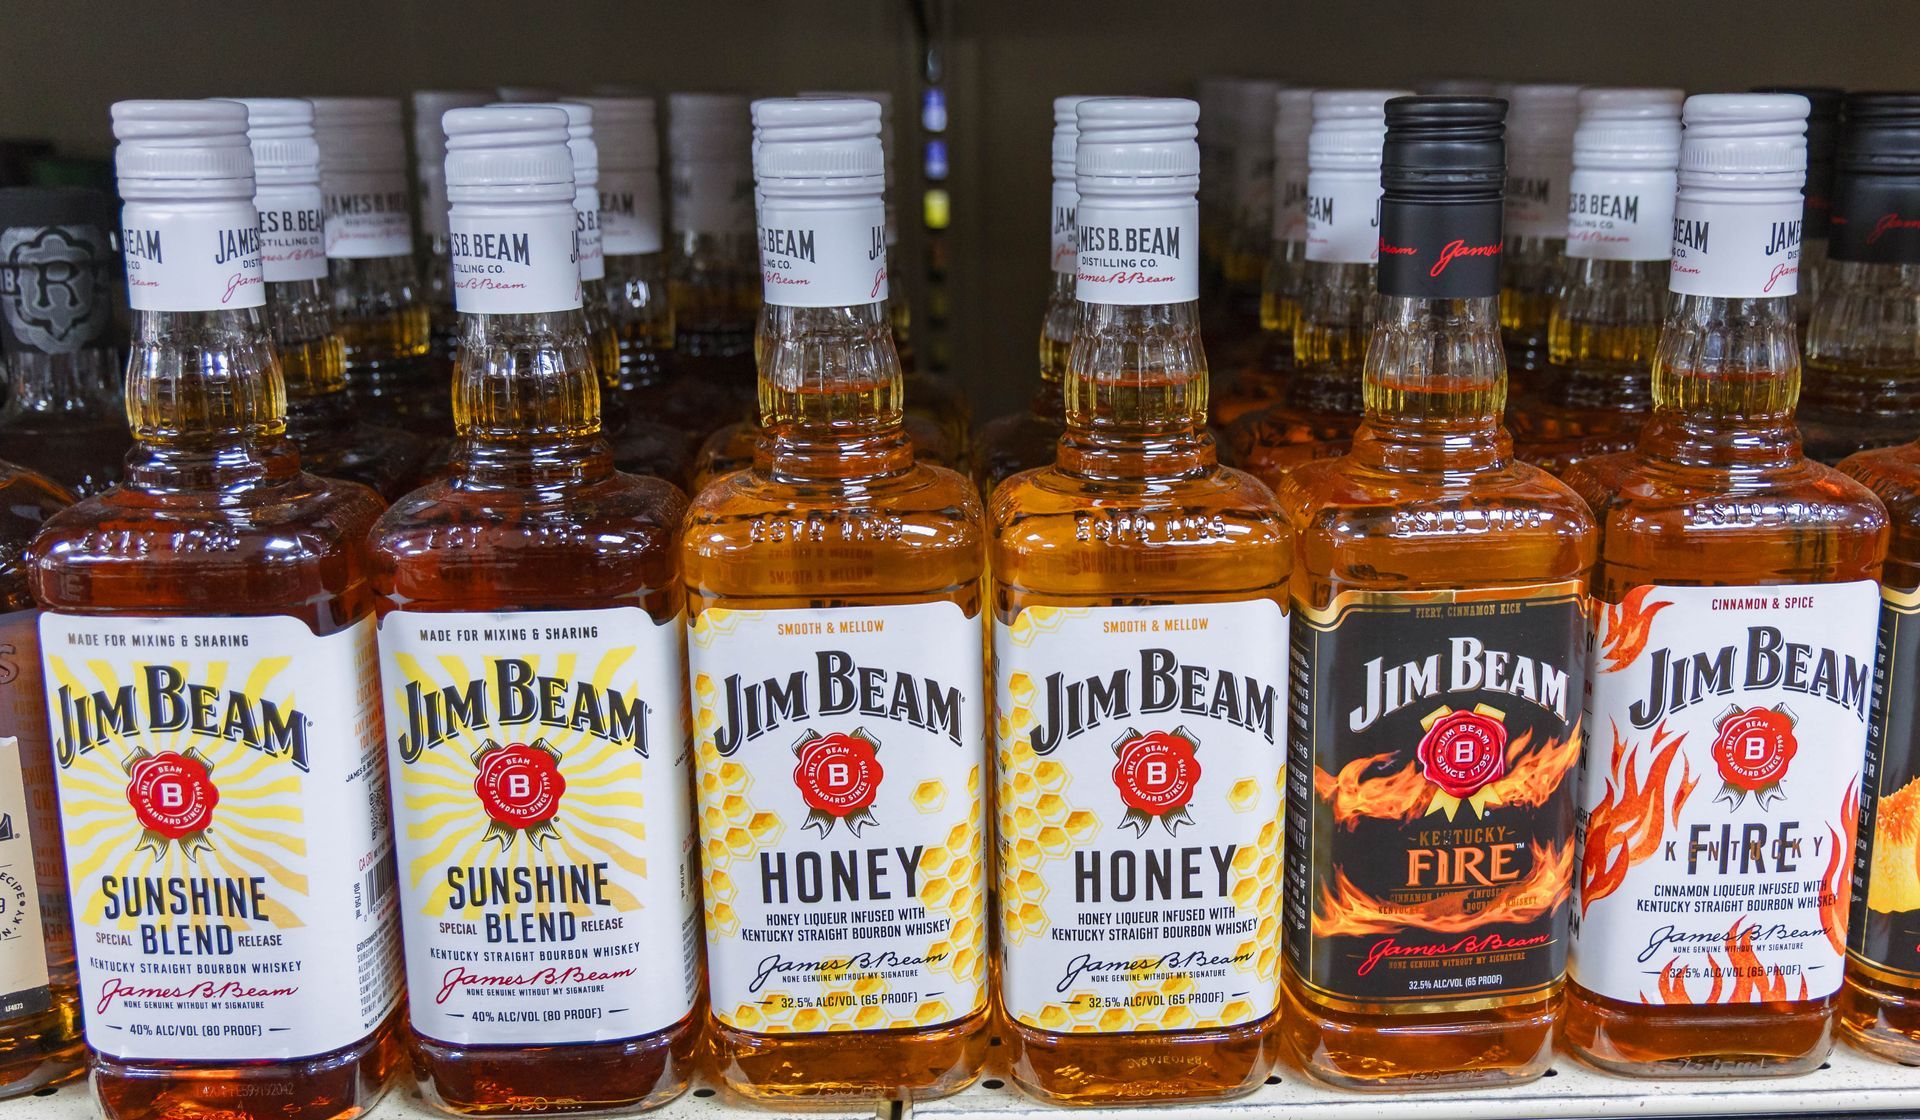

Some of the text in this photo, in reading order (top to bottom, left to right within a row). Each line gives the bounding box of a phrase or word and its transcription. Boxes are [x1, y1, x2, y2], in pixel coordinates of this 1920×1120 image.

[1055, 207, 1075, 234] JAM
[1590, 196, 1638, 223] BEAM
[215, 227, 259, 264] JAMES
[768, 230, 816, 263] BEAM
[1109, 228, 1122, 251] B.
[1126, 227, 1180, 259] BEAM
[1673, 218, 1709, 254] BEAM
[1766, 221, 1801, 255] JAME
[461, 234, 530, 266] B. BEAM
[1082, 257, 1158, 268] DISTILLING CO.
[1416, 603, 1521, 619] FIERY, CINNAMON KICK
[1712, 596, 1814, 610] CINNAMON & SPICE
[420, 626, 599, 642] MADE FOR MIXING & SHARING
[778, 620, 885, 636] SMOOTH & MELLOW
[1103, 618, 1209, 633] SMOOTH & MELLOW
[68, 633, 249, 648] MADE FOR MIXING & SHARING
[1349, 656, 1442, 734] JIM
[1448, 637, 1569, 726] BEAM
[1628, 645, 1735, 729] JIM
[1742, 625, 1869, 723] BEAM
[398, 658, 650, 765] JIM BEAM
[713, 649, 964, 757] JIM BEAM
[1030, 668, 1131, 756] JIM
[1139, 648, 1279, 746] BEAM
[57, 684, 136, 769] JIM
[143, 665, 311, 773] BEAM
[1745, 720, 1769, 729] BEAM
[1440, 724, 1489, 746] JIM BEAM
[826, 746, 850, 756] BEAM
[1145, 744, 1169, 753] BEAM
[1455, 741, 1473, 762] B
[1746, 738, 1765, 760] B
[506, 757, 531, 766] BEAM
[1147, 761, 1168, 784] B
[1437, 754, 1490, 778] SINCE 1795
[509, 775, 530, 797] B
[828, 763, 849, 786] B
[142, 780, 203, 824] THE STANDARD SINCE 1795
[161, 783, 183, 806] B
[1687, 821, 1800, 876] FIRE
[760, 846, 925, 905] HONEY
[1075, 843, 1237, 904] HONEY
[1405, 843, 1520, 886] FIRE
[447, 862, 611, 911] SUNSHINE
[1654, 880, 1827, 897] CINNAMON LIQUEUR INFUSED WITH
[101, 874, 269, 923] SUNSHINE
[1637, 894, 1838, 913] KENTUCKY STRAIGHT BOURBON WHISKEY
[766, 907, 926, 927] HONEY LIQUEUR INFUSED WITH
[1078, 906, 1236, 925] HONEY LIQUEUR INFUSED WITH
[439, 911, 624, 944] SPECIAL BLEND RELEASE
[742, 918, 952, 942] KENTUCKY STRAIGHT BOURBON WHISKEY
[1052, 916, 1259, 942] KENTUCKY STRAIGHT BOURBON WHISKEY
[96, 923, 283, 956] SPECIAL BLEND RELEASE
[430, 942, 641, 962] KENTUCKY STRAIGHT BOURBON WHISKEY
[90, 956, 302, 975] KENTUCKY STRAIGHT BOURBON WHISKEY
[1091, 968, 1226, 983] NONE GENUINE WITHOUT MY SIGNATURE
[1670, 967, 1700, 978] 32.5%
[1704, 966, 1744, 977] ALC/VOL
[1409, 974, 1502, 990] 32.5% ALC/VOL (65 PROOF)
[781, 994, 813, 1010] 32.5%
[815, 992, 858, 1008] ALC/VOL
[1089, 994, 1121, 1008] 32.5%
[1123, 992, 1166, 1007] ALC/VOL
[472, 1009, 495, 1023] 40%
[498, 1008, 540, 1023] ALC/VOL
[130, 1024, 153, 1036] 40%
[156, 1025, 199, 1036] ALC/VOL
